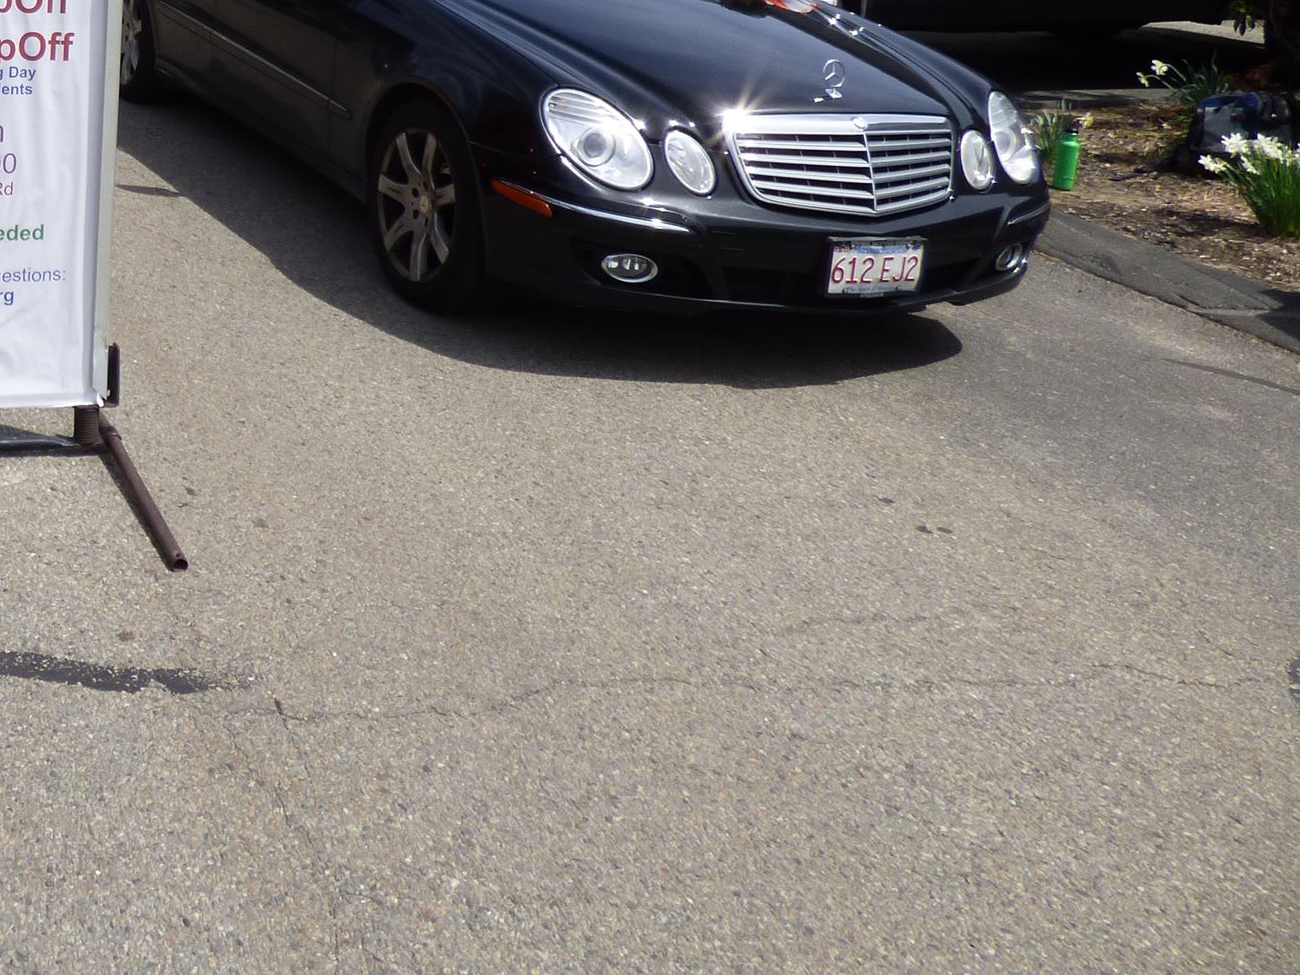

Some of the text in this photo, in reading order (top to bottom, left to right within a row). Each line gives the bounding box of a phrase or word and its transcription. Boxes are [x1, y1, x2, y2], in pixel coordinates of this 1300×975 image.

[9, 67, 36, 81] Day
[832, 256, 918, 284] 612 EJ2
